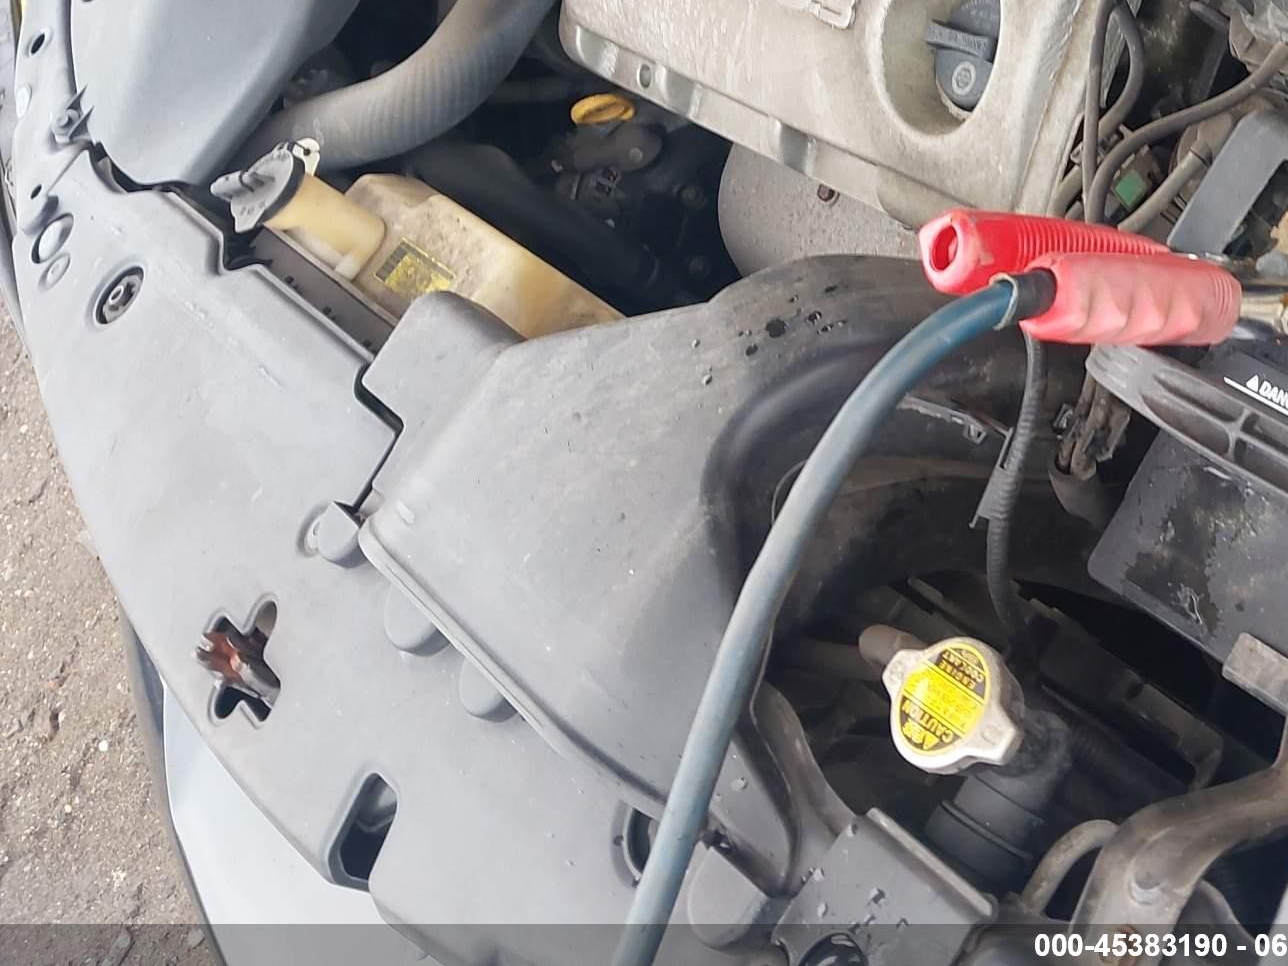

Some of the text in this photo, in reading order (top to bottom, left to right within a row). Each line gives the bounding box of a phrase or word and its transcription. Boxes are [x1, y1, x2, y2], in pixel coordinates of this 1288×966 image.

[938, 660, 977, 690] ENGINE
[942, 649, 986, 683] COOLANT
[902, 699, 953, 742] CAUTION
